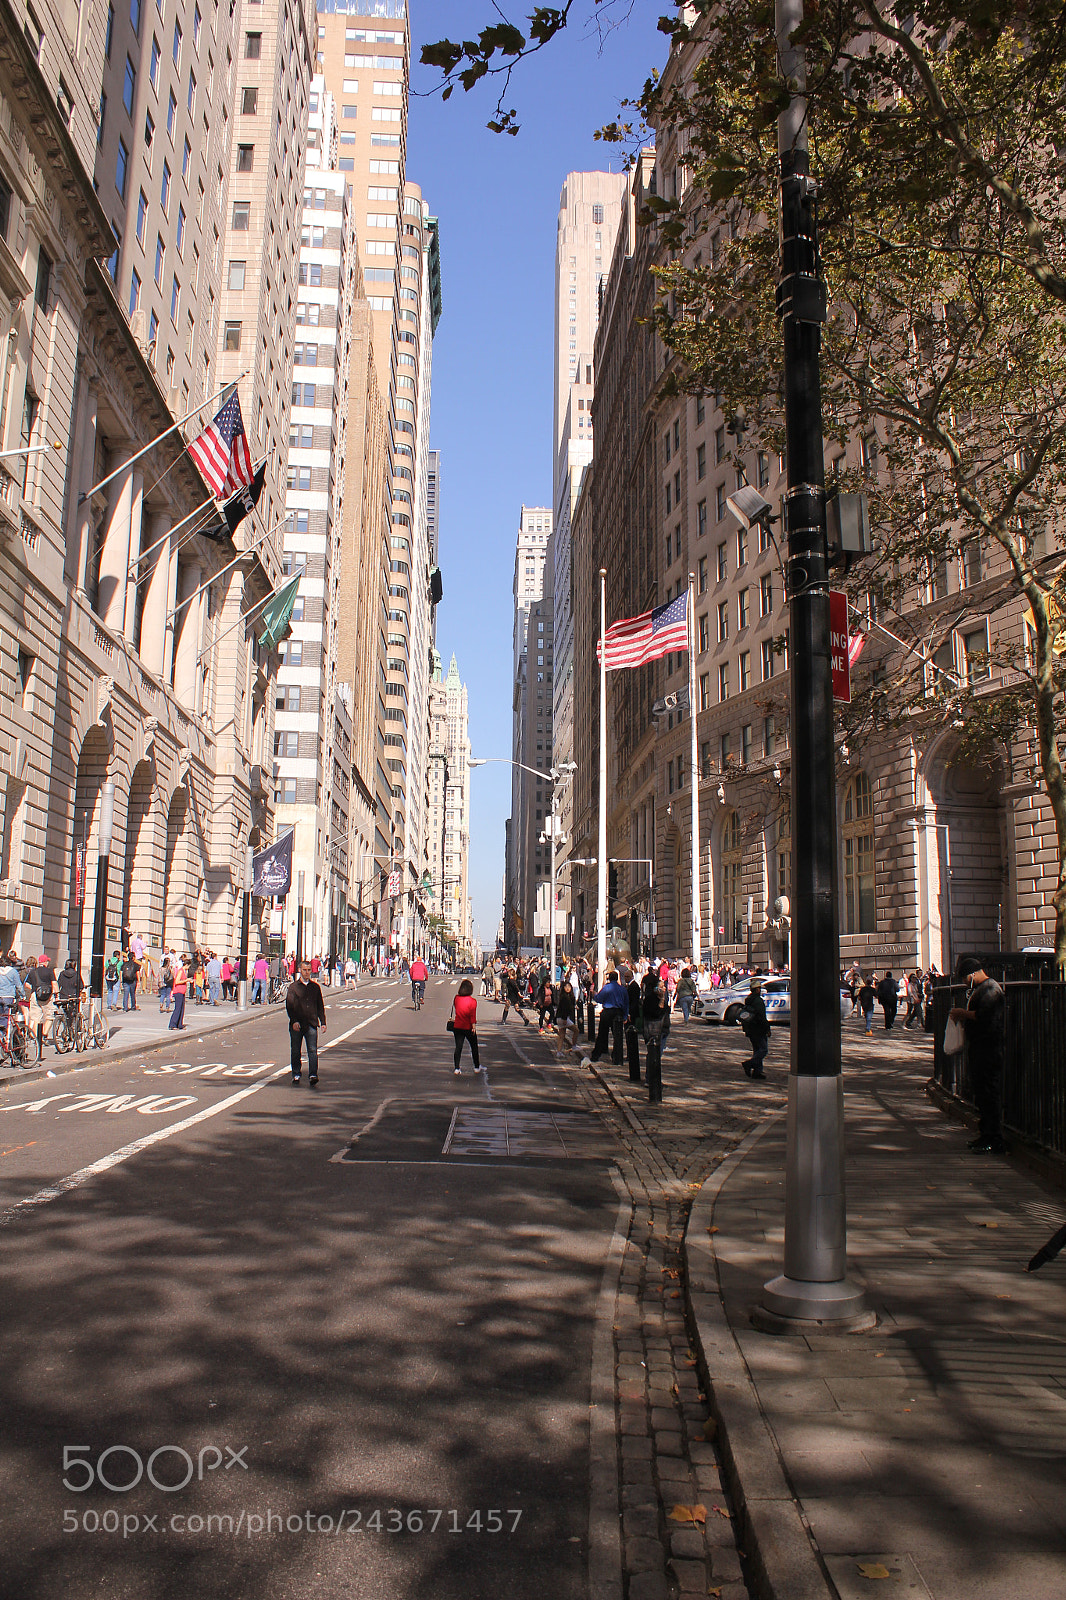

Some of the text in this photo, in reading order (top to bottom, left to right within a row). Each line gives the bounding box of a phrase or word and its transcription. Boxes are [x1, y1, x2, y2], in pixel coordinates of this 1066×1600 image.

[764, 999, 786, 1008] YPD
[143, 1063, 275, 1077] BUS
[0, 1093, 199, 1114] ONLY
